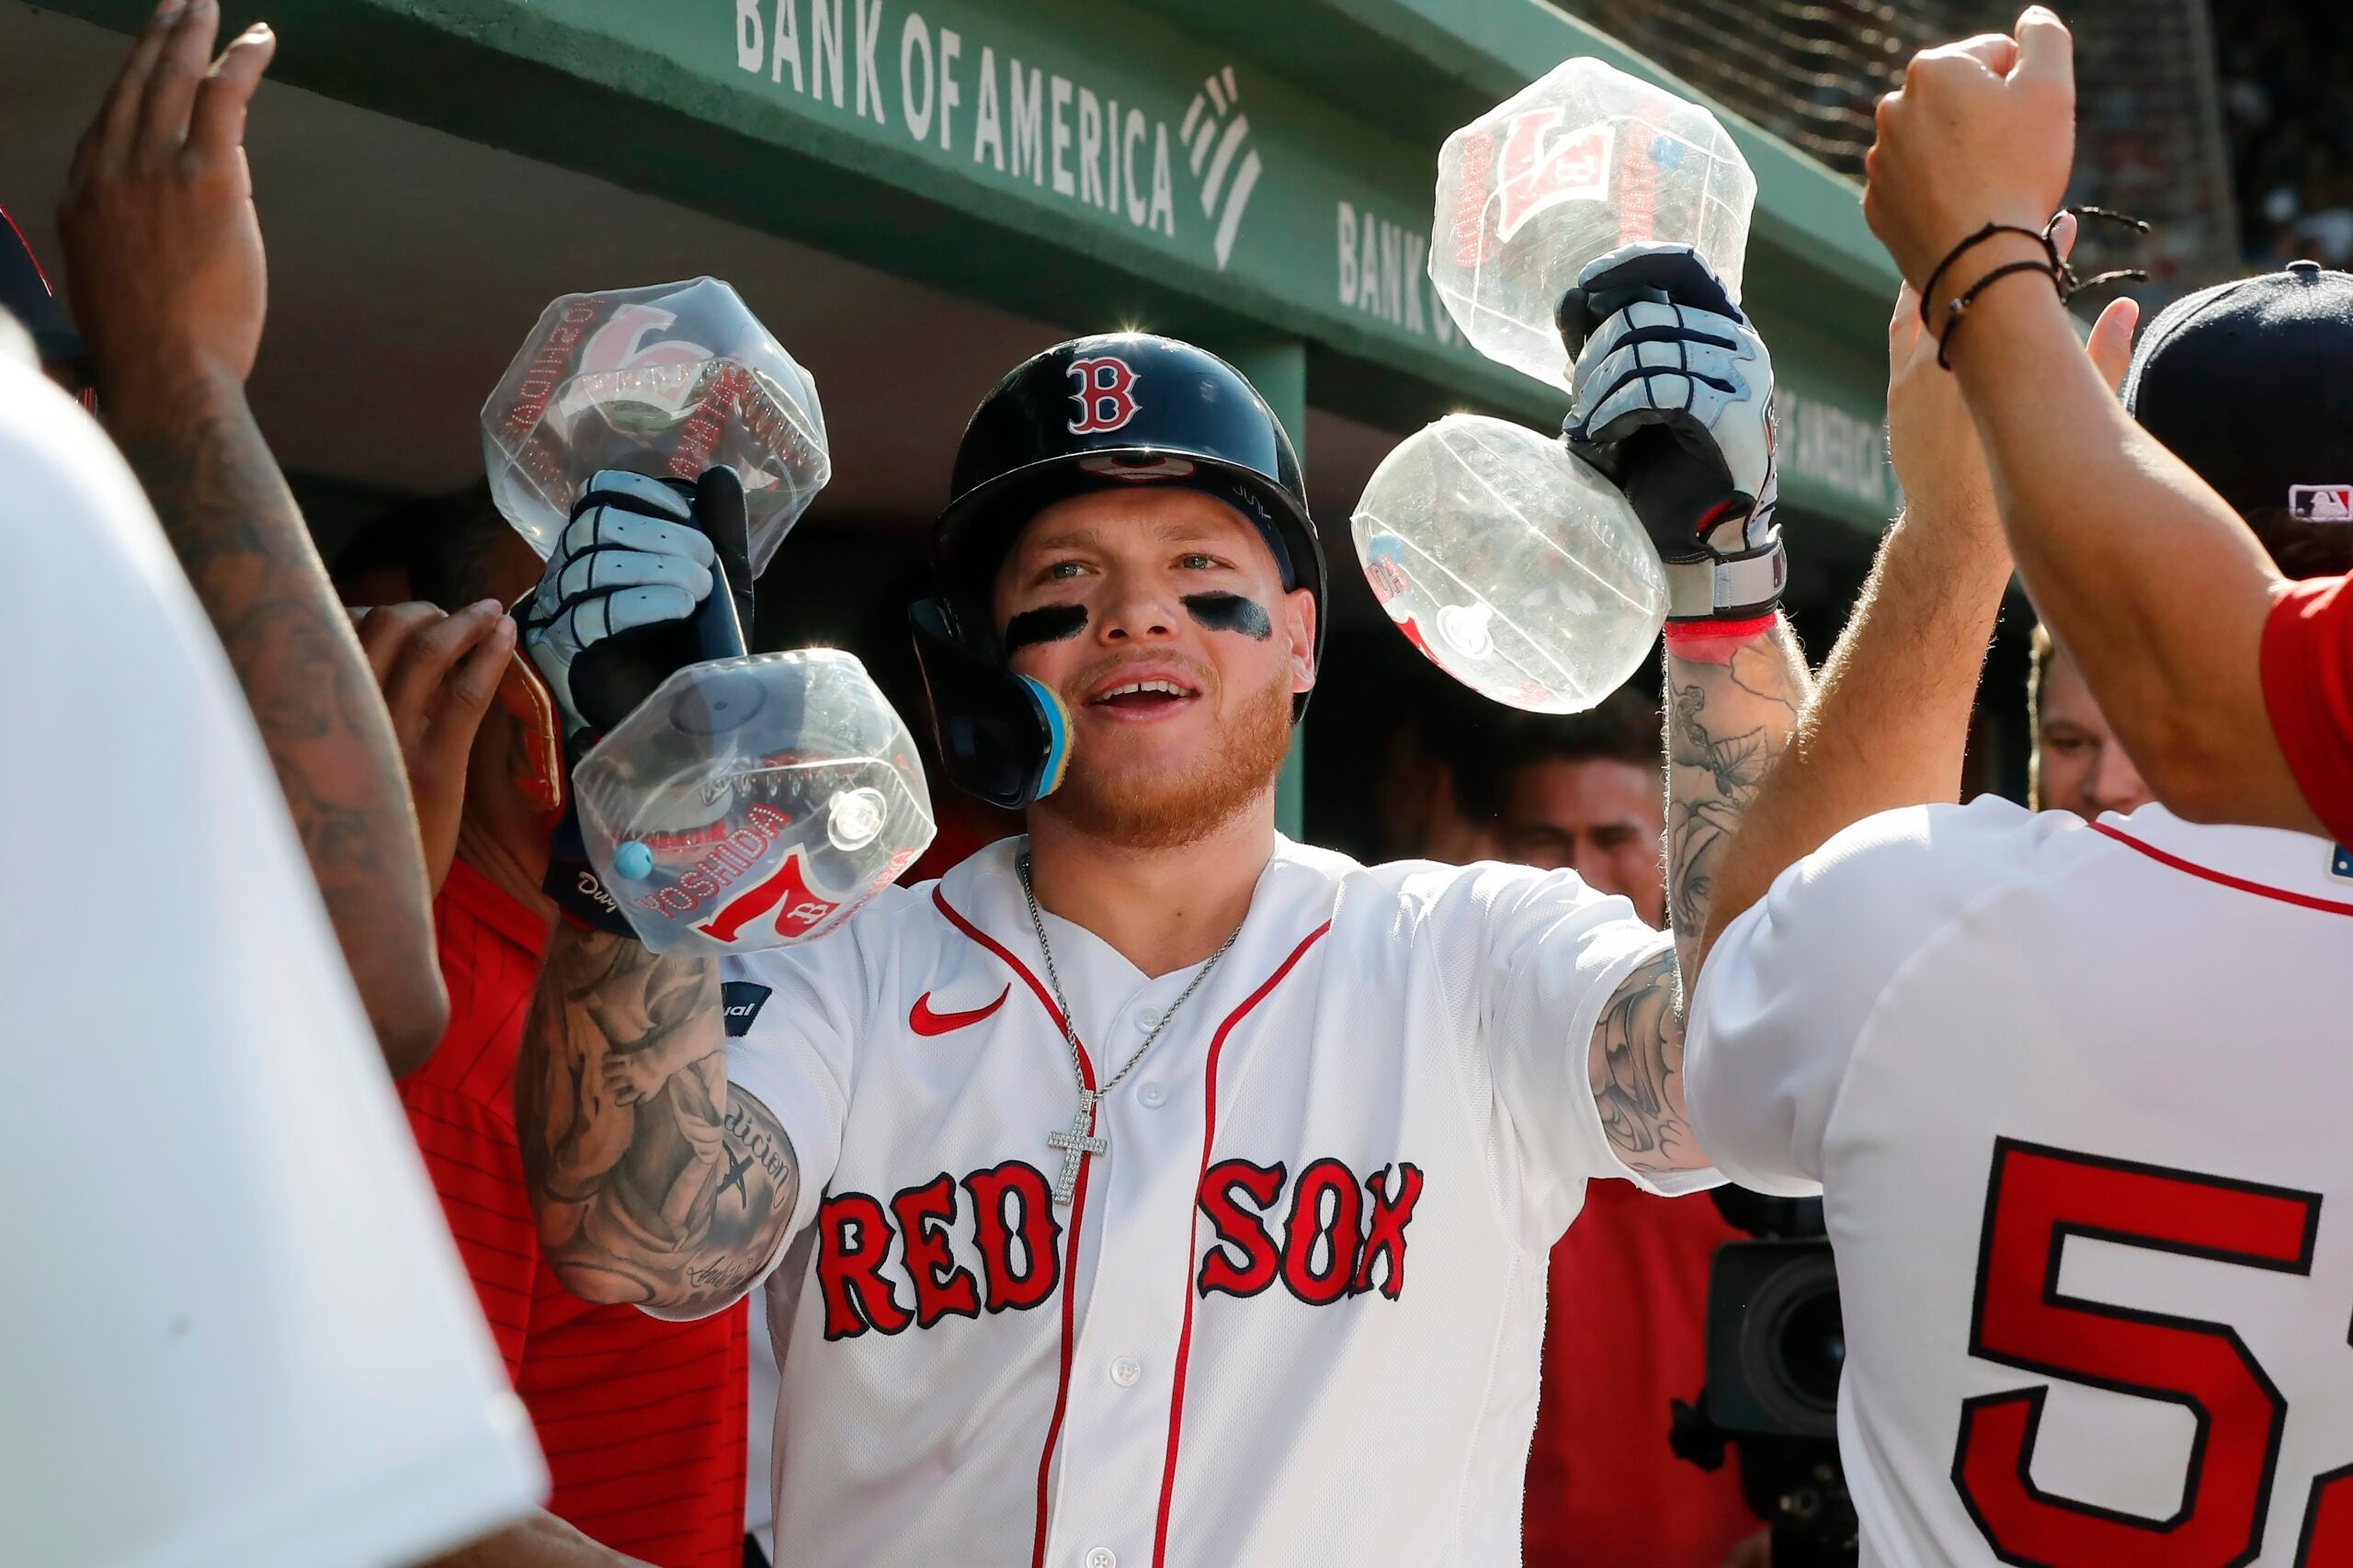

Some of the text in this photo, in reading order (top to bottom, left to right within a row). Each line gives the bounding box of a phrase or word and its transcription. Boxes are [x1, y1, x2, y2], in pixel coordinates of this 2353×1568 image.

[735, 0, 1175, 238] BANK OF AMERICA
[1337, 199, 1426, 335] BANK
[1066, 356, 1142, 435] B
[636, 803, 791, 920] YOSHIDA
[816, 1156, 1424, 1343] RED SOX
[1950, 1135, 2353, 1568] 5
